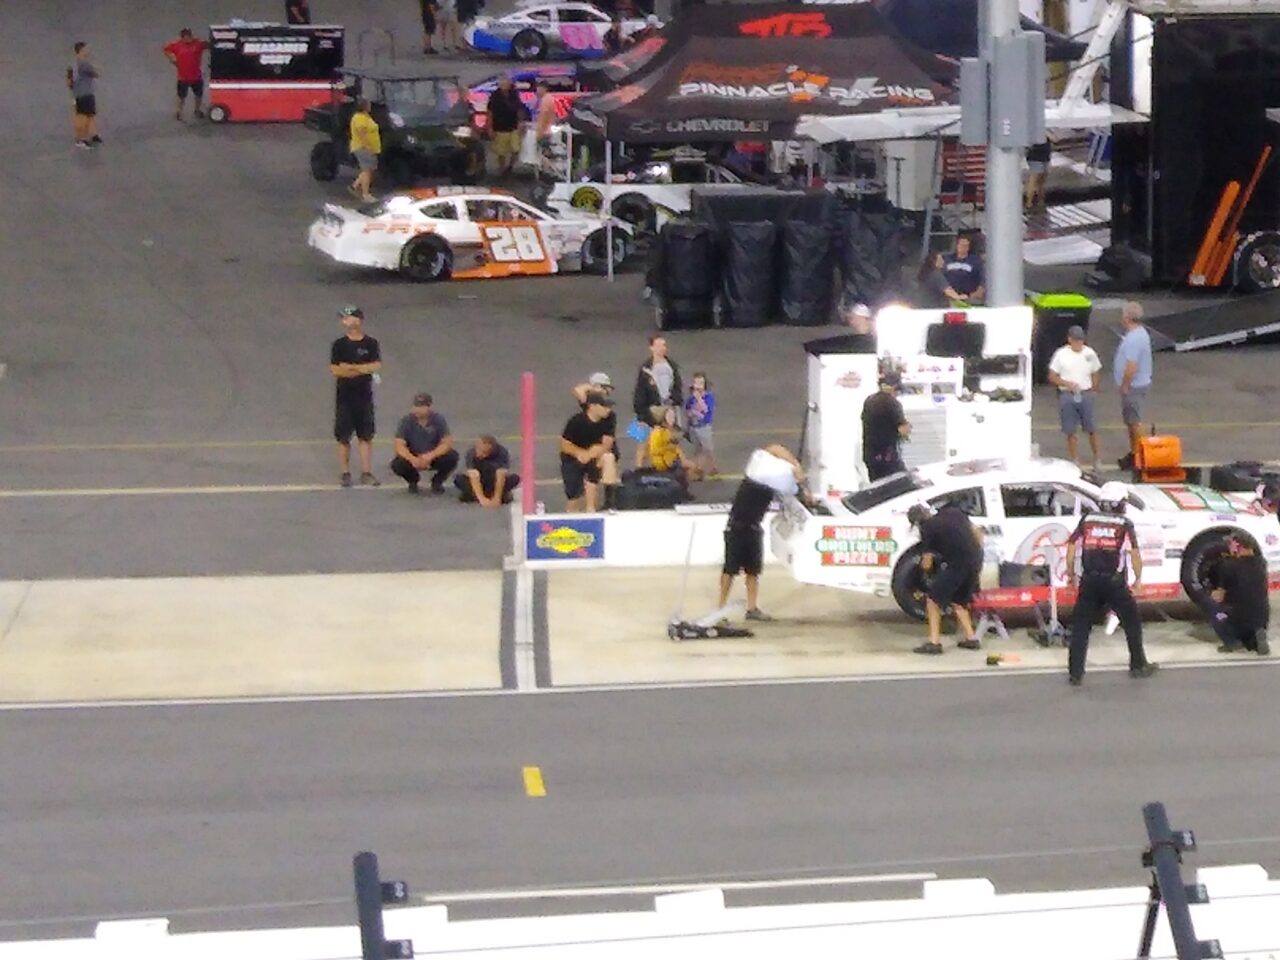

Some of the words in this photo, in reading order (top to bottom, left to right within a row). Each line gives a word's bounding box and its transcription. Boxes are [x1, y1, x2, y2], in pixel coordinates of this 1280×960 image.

[680, 81, 822, 98] PINNACLE
[829, 83, 935, 101] RACING
[666, 120, 769, 132] CHEVROLET
